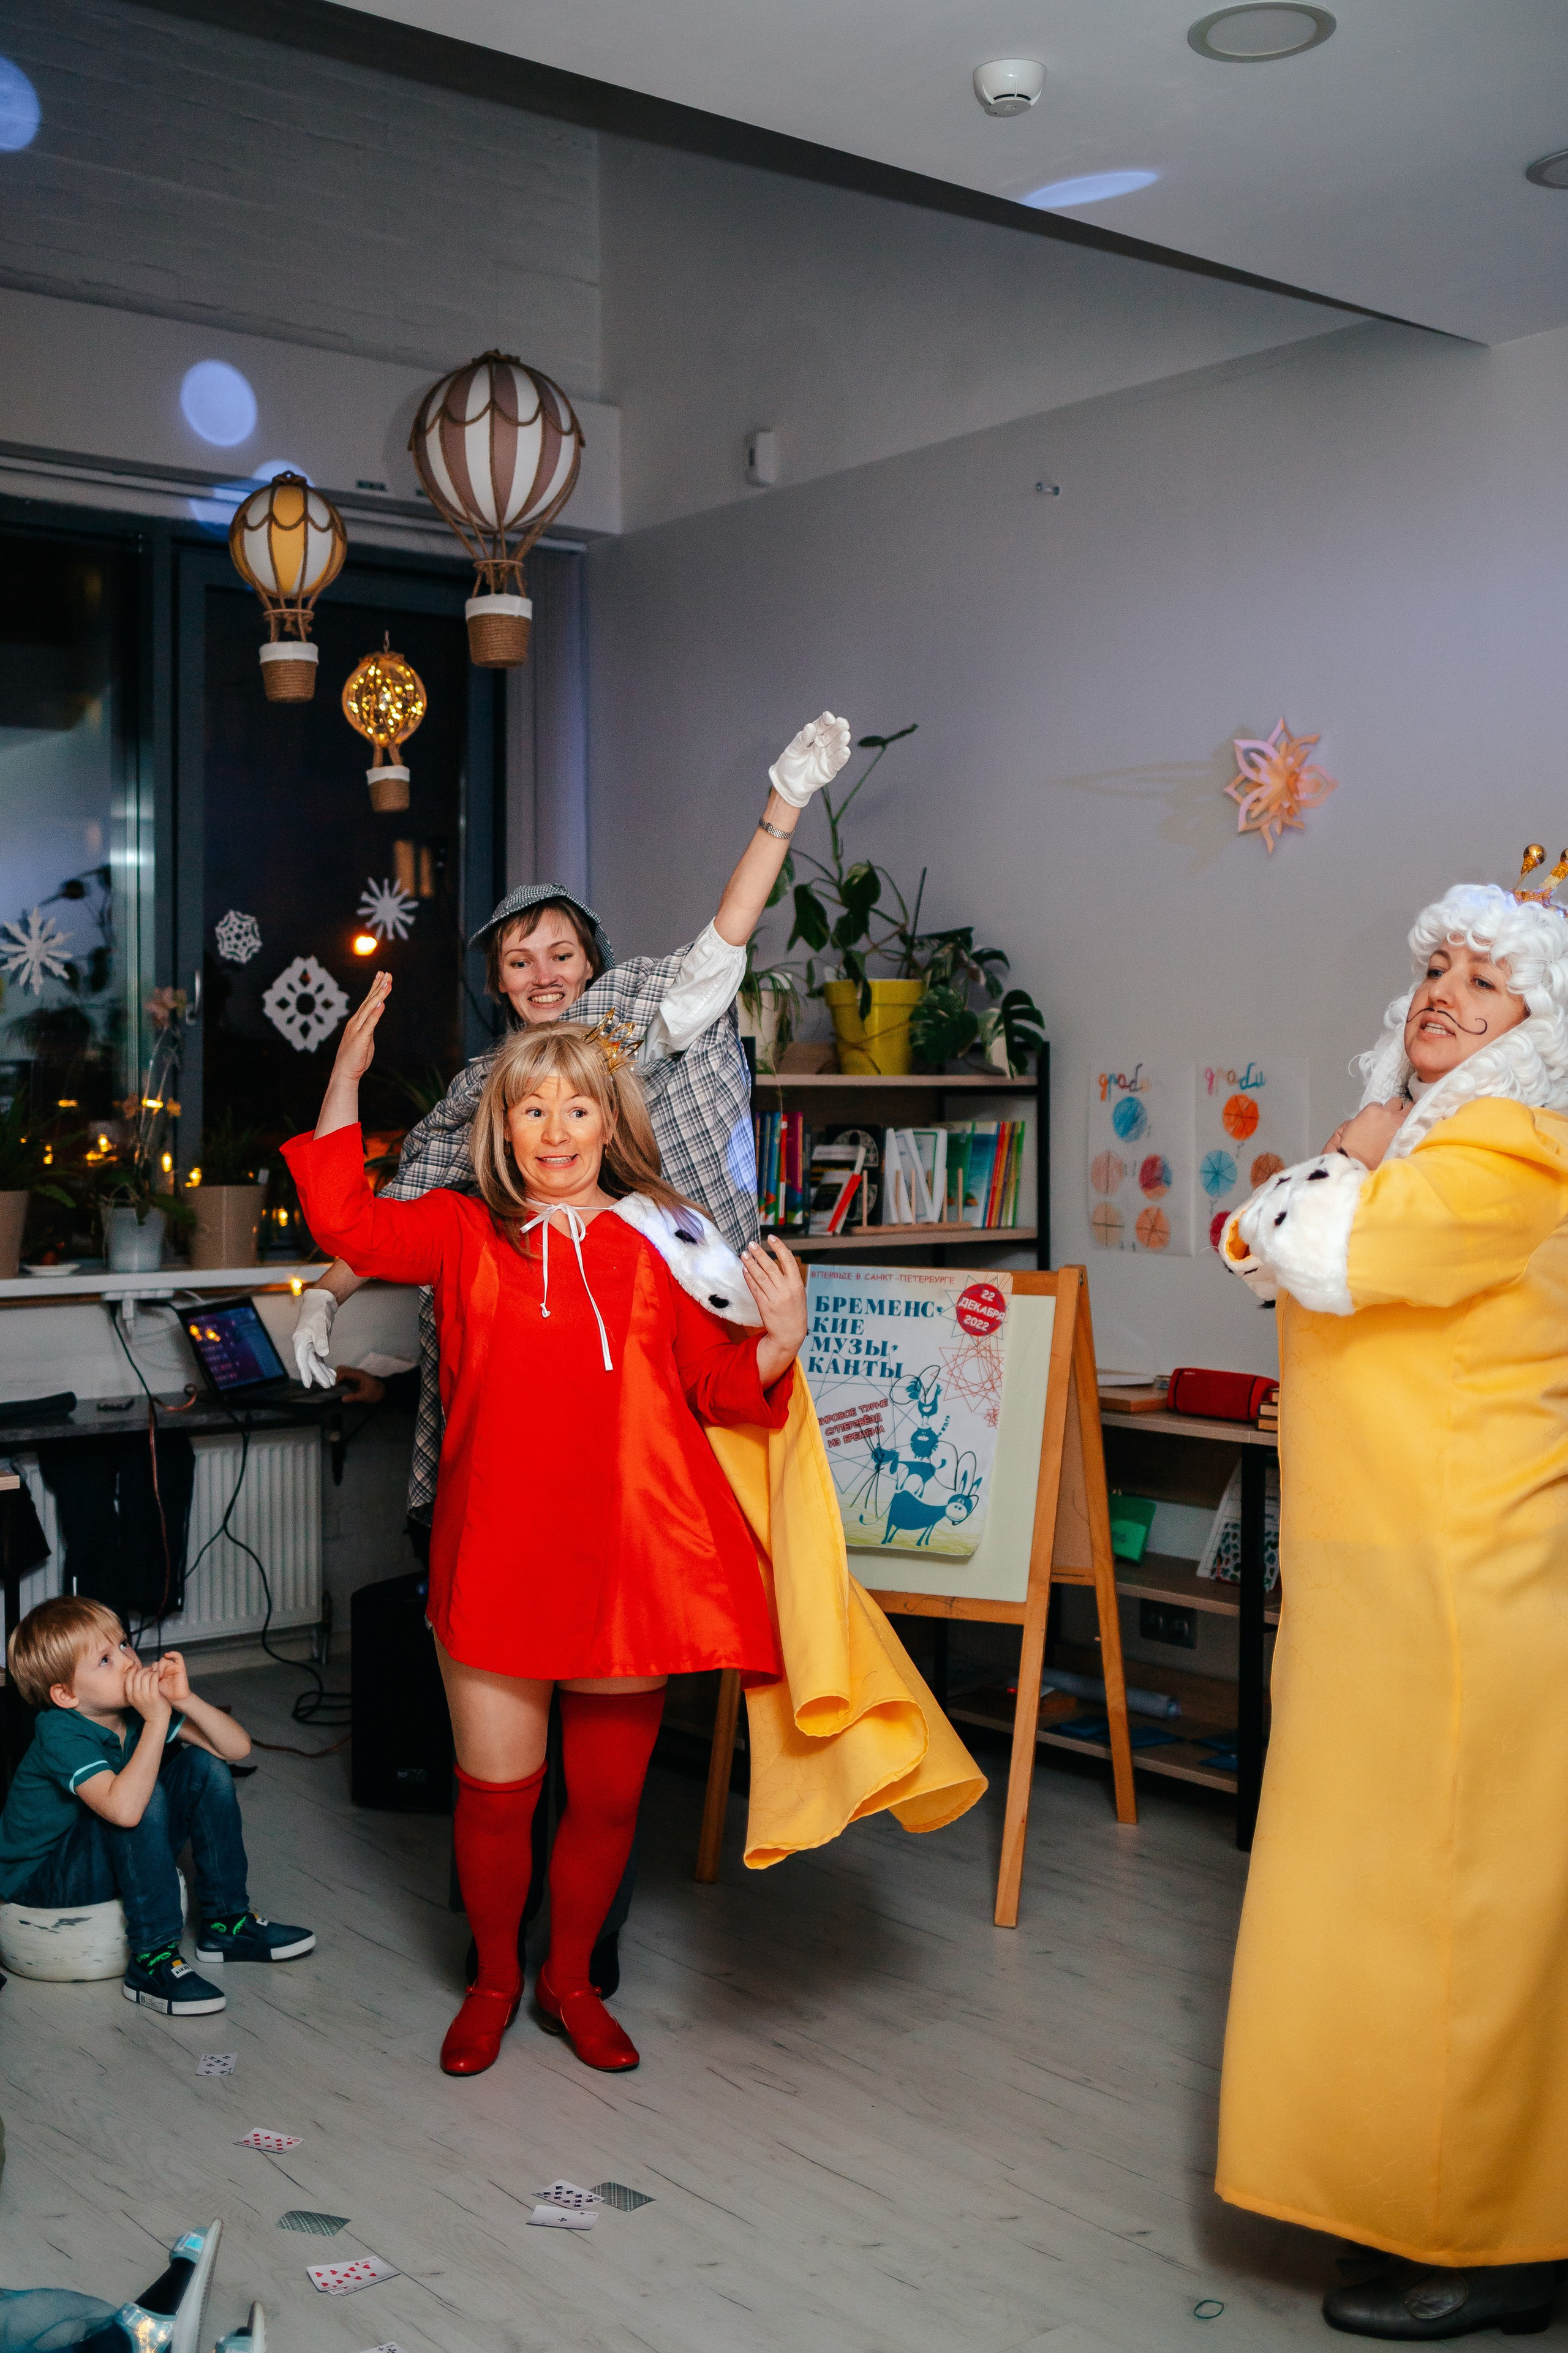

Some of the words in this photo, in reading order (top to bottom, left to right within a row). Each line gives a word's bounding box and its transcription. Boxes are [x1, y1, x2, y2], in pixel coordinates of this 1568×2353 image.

[811, 1271, 852, 1280] ВПЕРВЫЕ
[981, 1290, 995, 1302] 22
[959, 1297, 1006, 1321] ДЕКАБРЯ
[813, 1316, 865, 1335] КИЕ
[963, 1314, 989, 1331] 2022
[808, 1356, 903, 1378] КАНТЫ
[859, 1399, 889, 1413] ТУРНЕ
[828, 1438, 841, 1448] ИЗ
[843, 1426, 885, 1444] БРЕМЕНА
